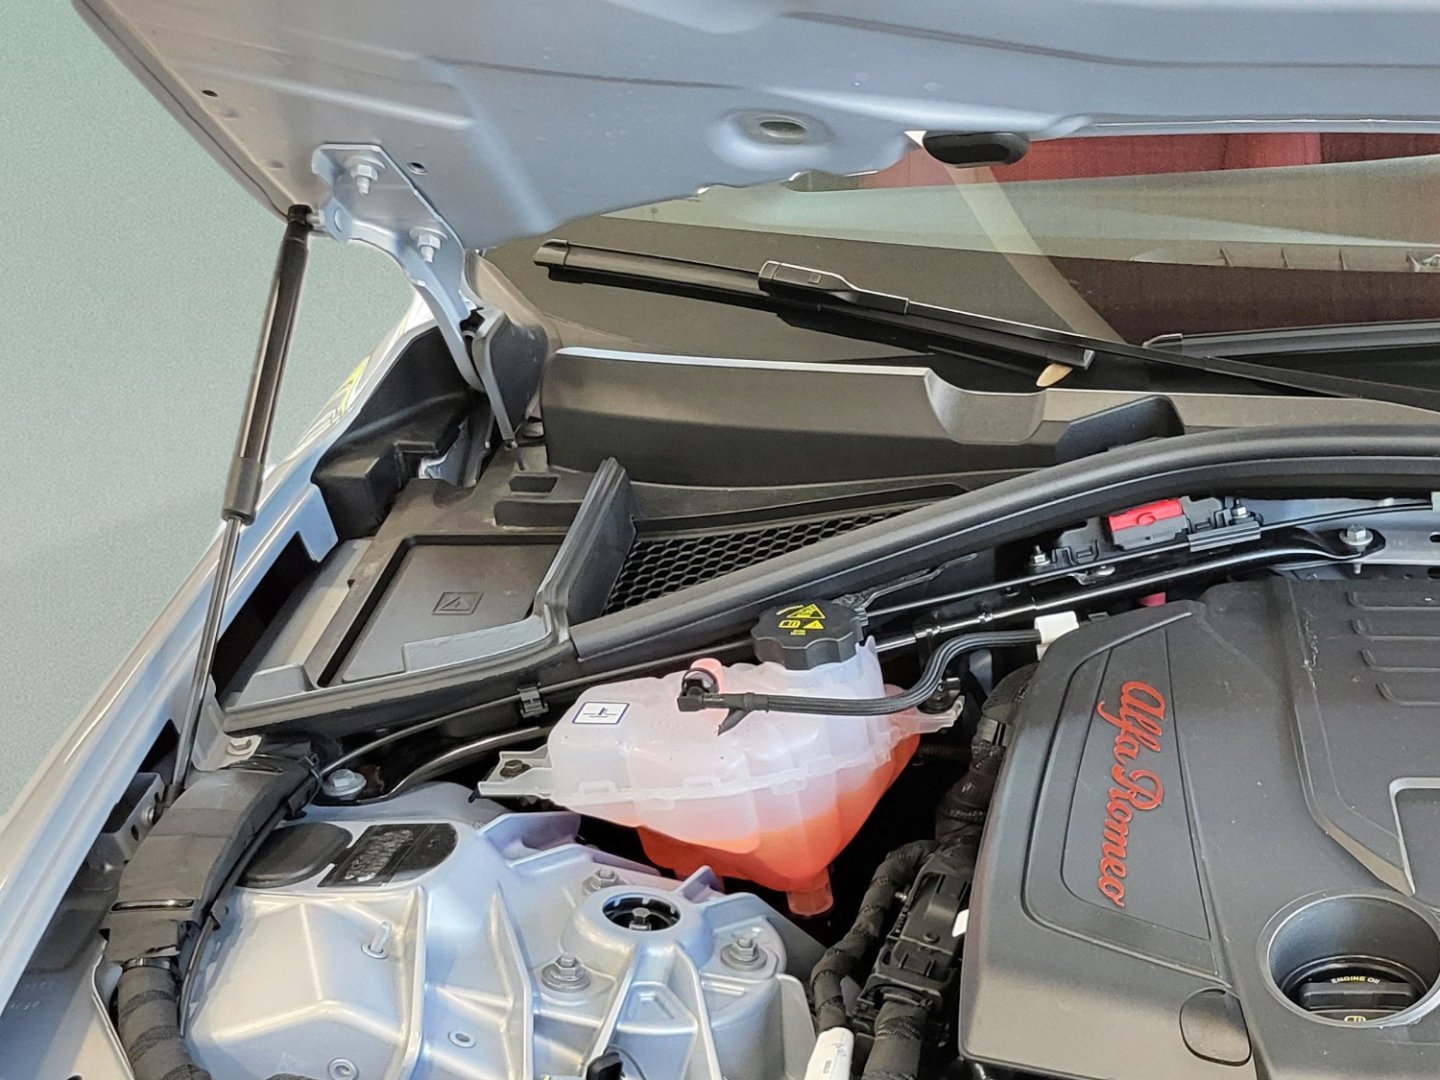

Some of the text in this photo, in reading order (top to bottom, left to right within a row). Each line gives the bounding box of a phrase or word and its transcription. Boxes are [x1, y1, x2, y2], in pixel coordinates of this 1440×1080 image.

[1097, 681, 1166, 908] Alfa Romeo
[1331, 975, 1366, 984] ENGINE
